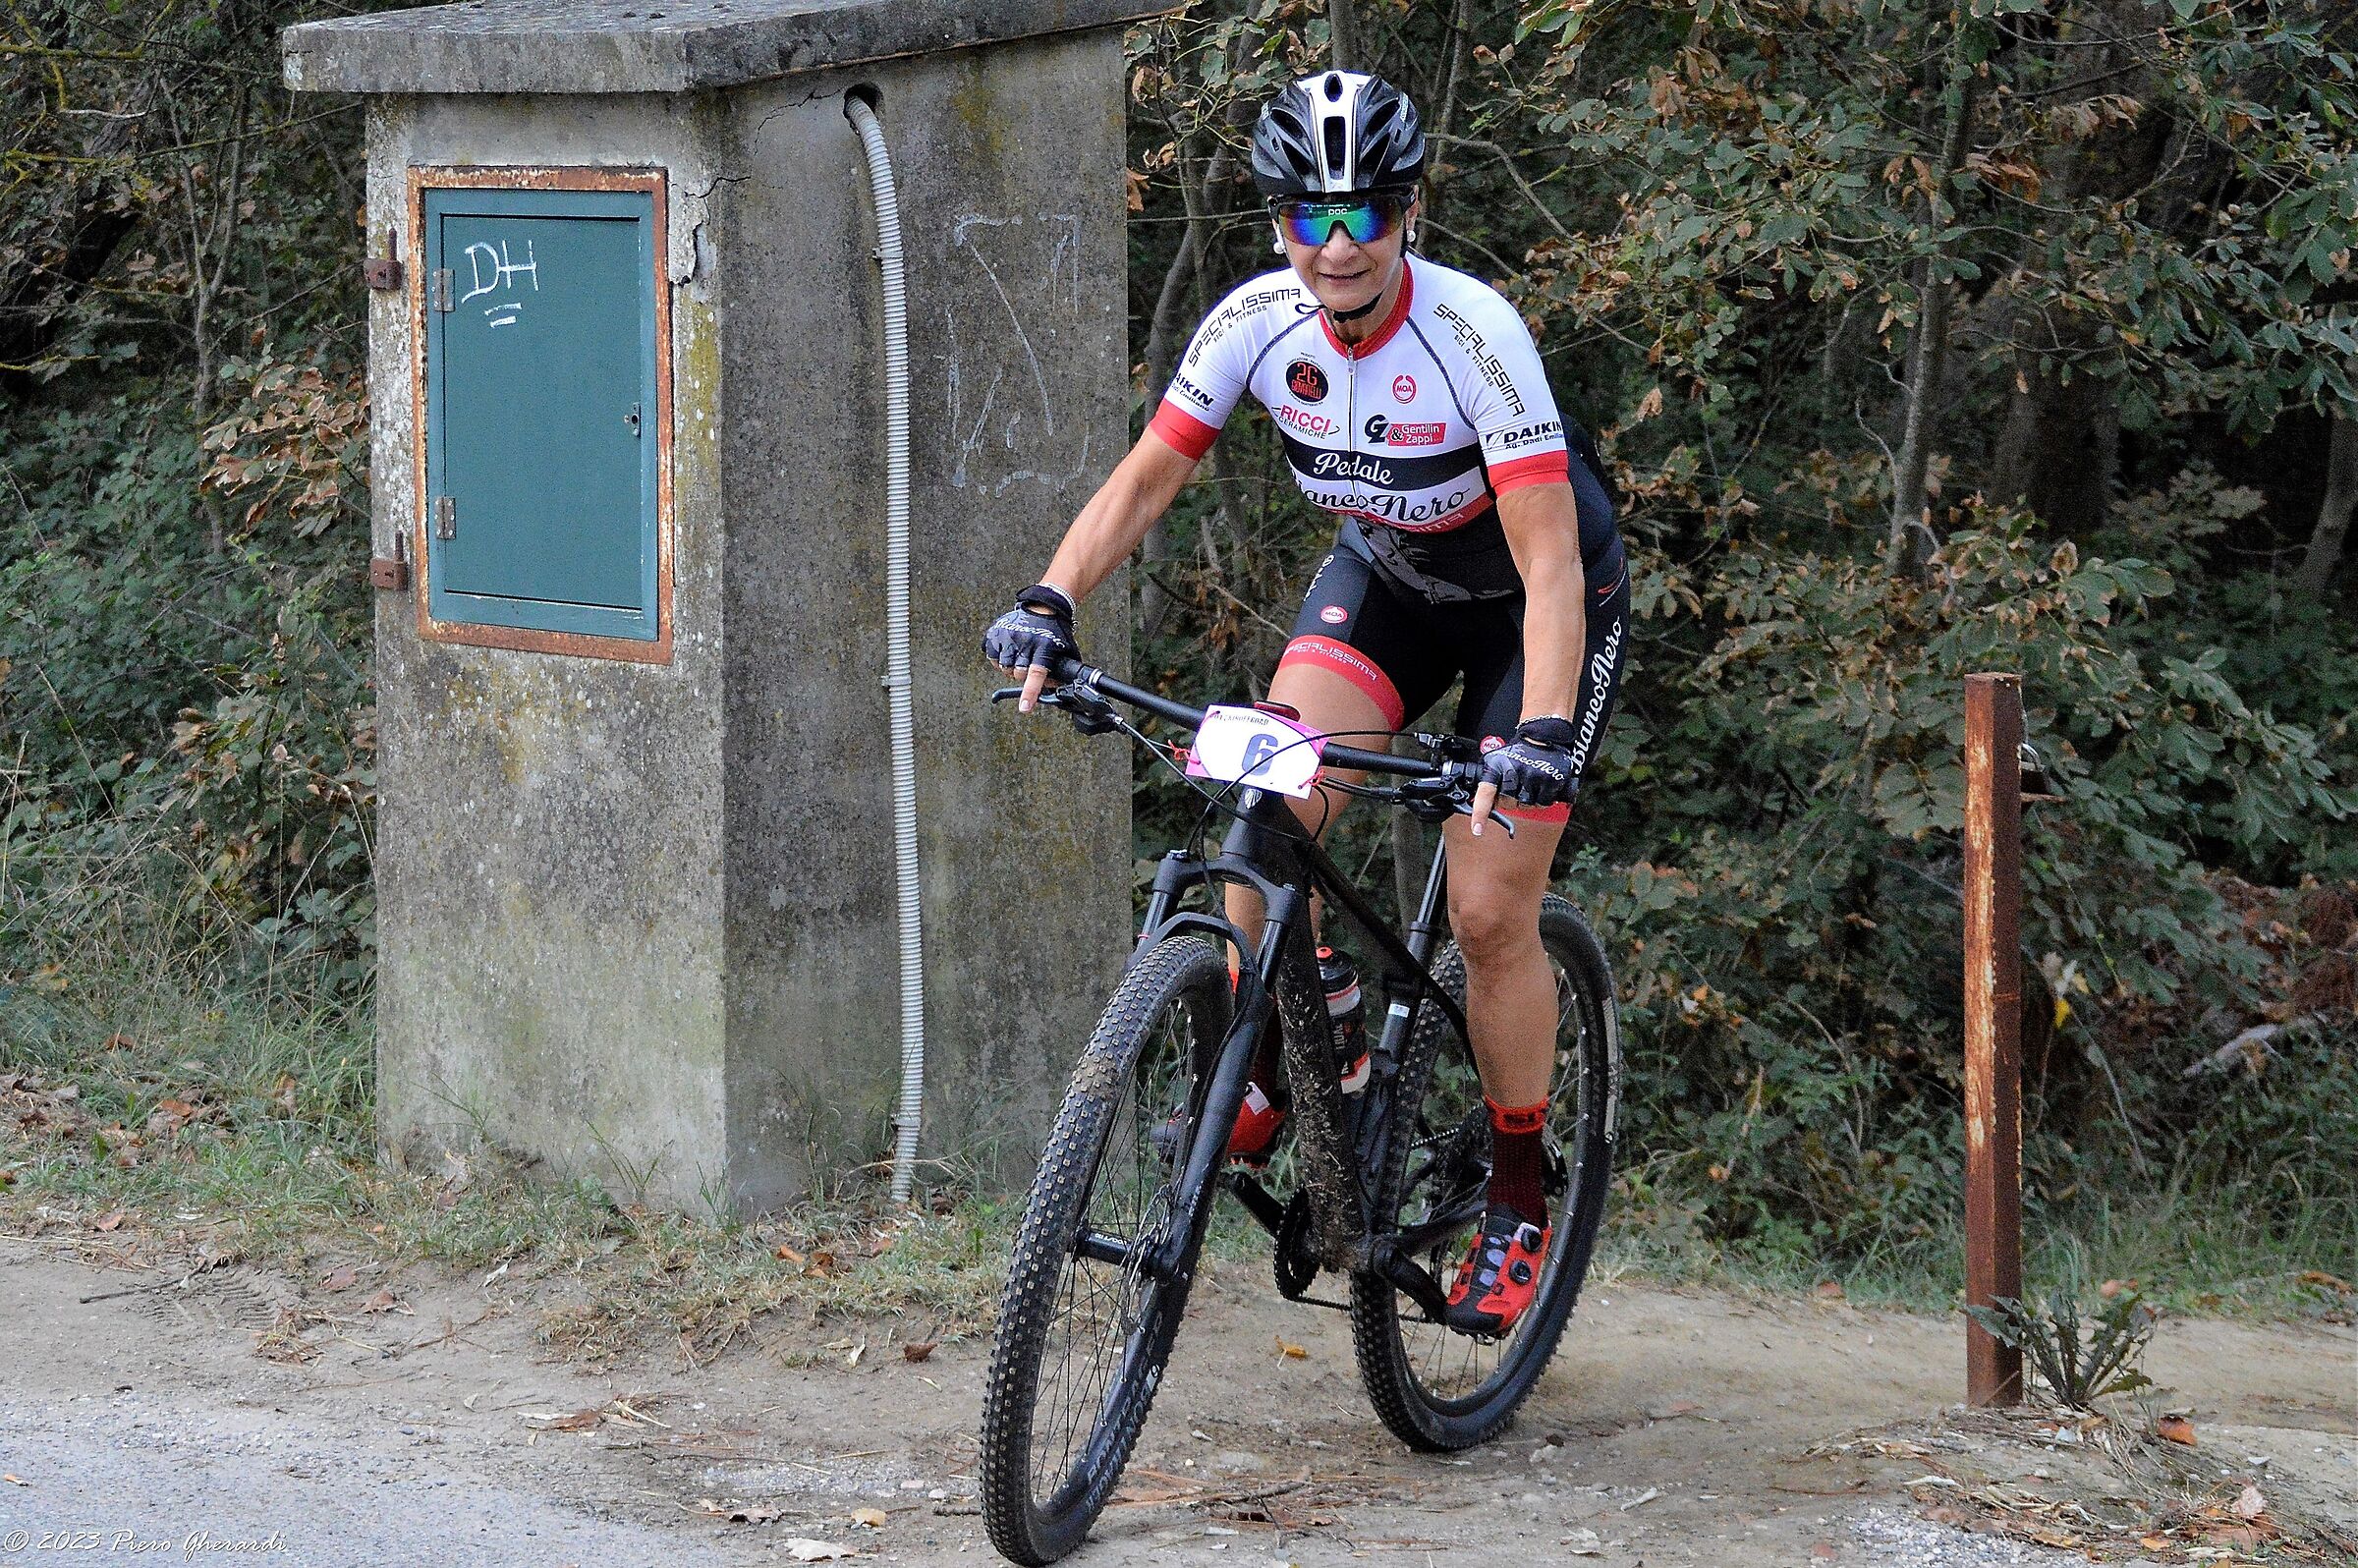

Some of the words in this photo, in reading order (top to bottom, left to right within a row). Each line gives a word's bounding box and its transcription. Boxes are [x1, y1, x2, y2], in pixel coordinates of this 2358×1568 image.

[462, 240, 539, 304] DH
[1188, 288, 1301, 367] SPECIALISSIMA
[1236, 306, 1267, 322] FITNESS
[1433, 303, 1526, 418] SPECIALISSIMA
[1454, 334, 1465, 348] BICI
[1472, 356, 1494, 387] FITNESS
[1176, 372, 1214, 406] AIKIN
[1279, 417, 1327, 440] CERAMICHE
[1280, 405, 1331, 432] RICCI
[1402, 423, 1440, 434] Gentilin
[1406, 434, 1433, 445] Zappi
[1313, 452, 1394, 485] Pedale
[1242, 733, 1278, 776] 6
